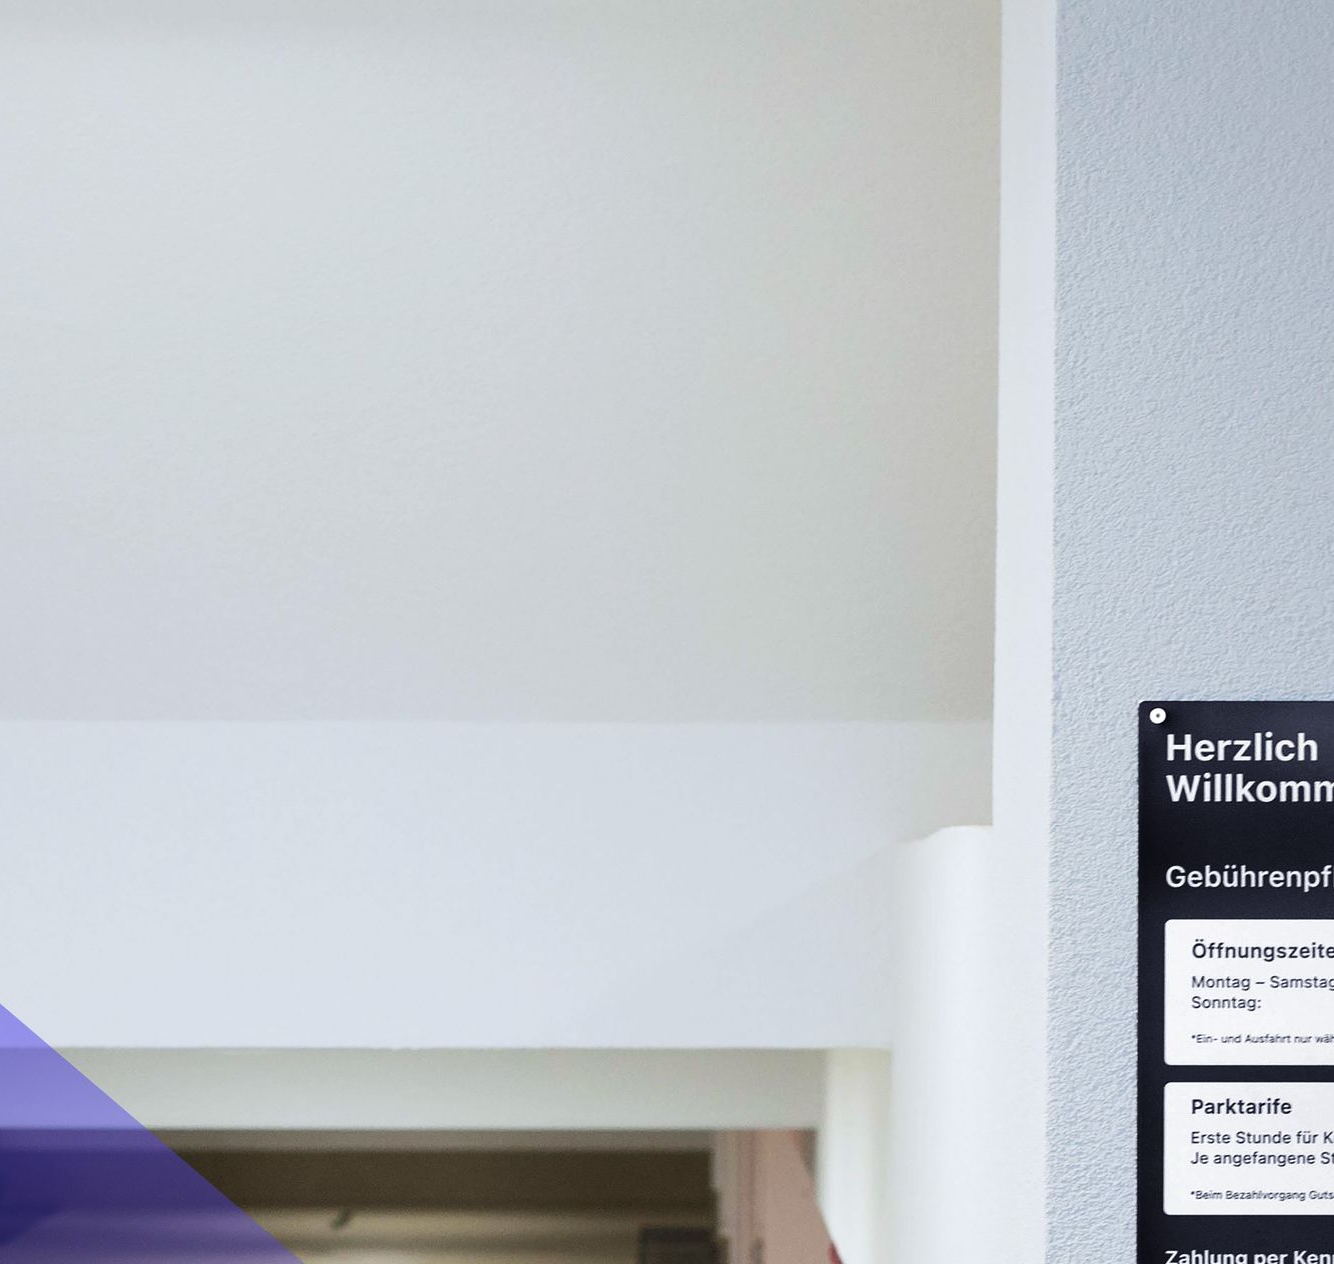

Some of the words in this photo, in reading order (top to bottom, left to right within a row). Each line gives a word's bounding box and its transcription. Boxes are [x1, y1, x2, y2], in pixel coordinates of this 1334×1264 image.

[1166, 731, 1318, 762] Herzlich
[1192, 976, 1251, 991] Montag
[1192, 996, 1261, 1011] Sonntag:
[1221, 1033, 1242, 1044] und
[1244, 1033, 1291, 1044] Ausfahrt
[1293, 1036, 1312, 1044] nur
[1191, 1098, 1292, 1116] Parktarife
[1190, 1131, 1232, 1145] Erste
[1235, 1131, 1293, 1145] Stunde
[1296, 1130, 1319, 1145] für
[1190, 1151, 1209, 1165] Je
[1213, 1150, 1316, 1168] angefangene
[1225, 1190, 1306, 1202] Bezahlvorgang
